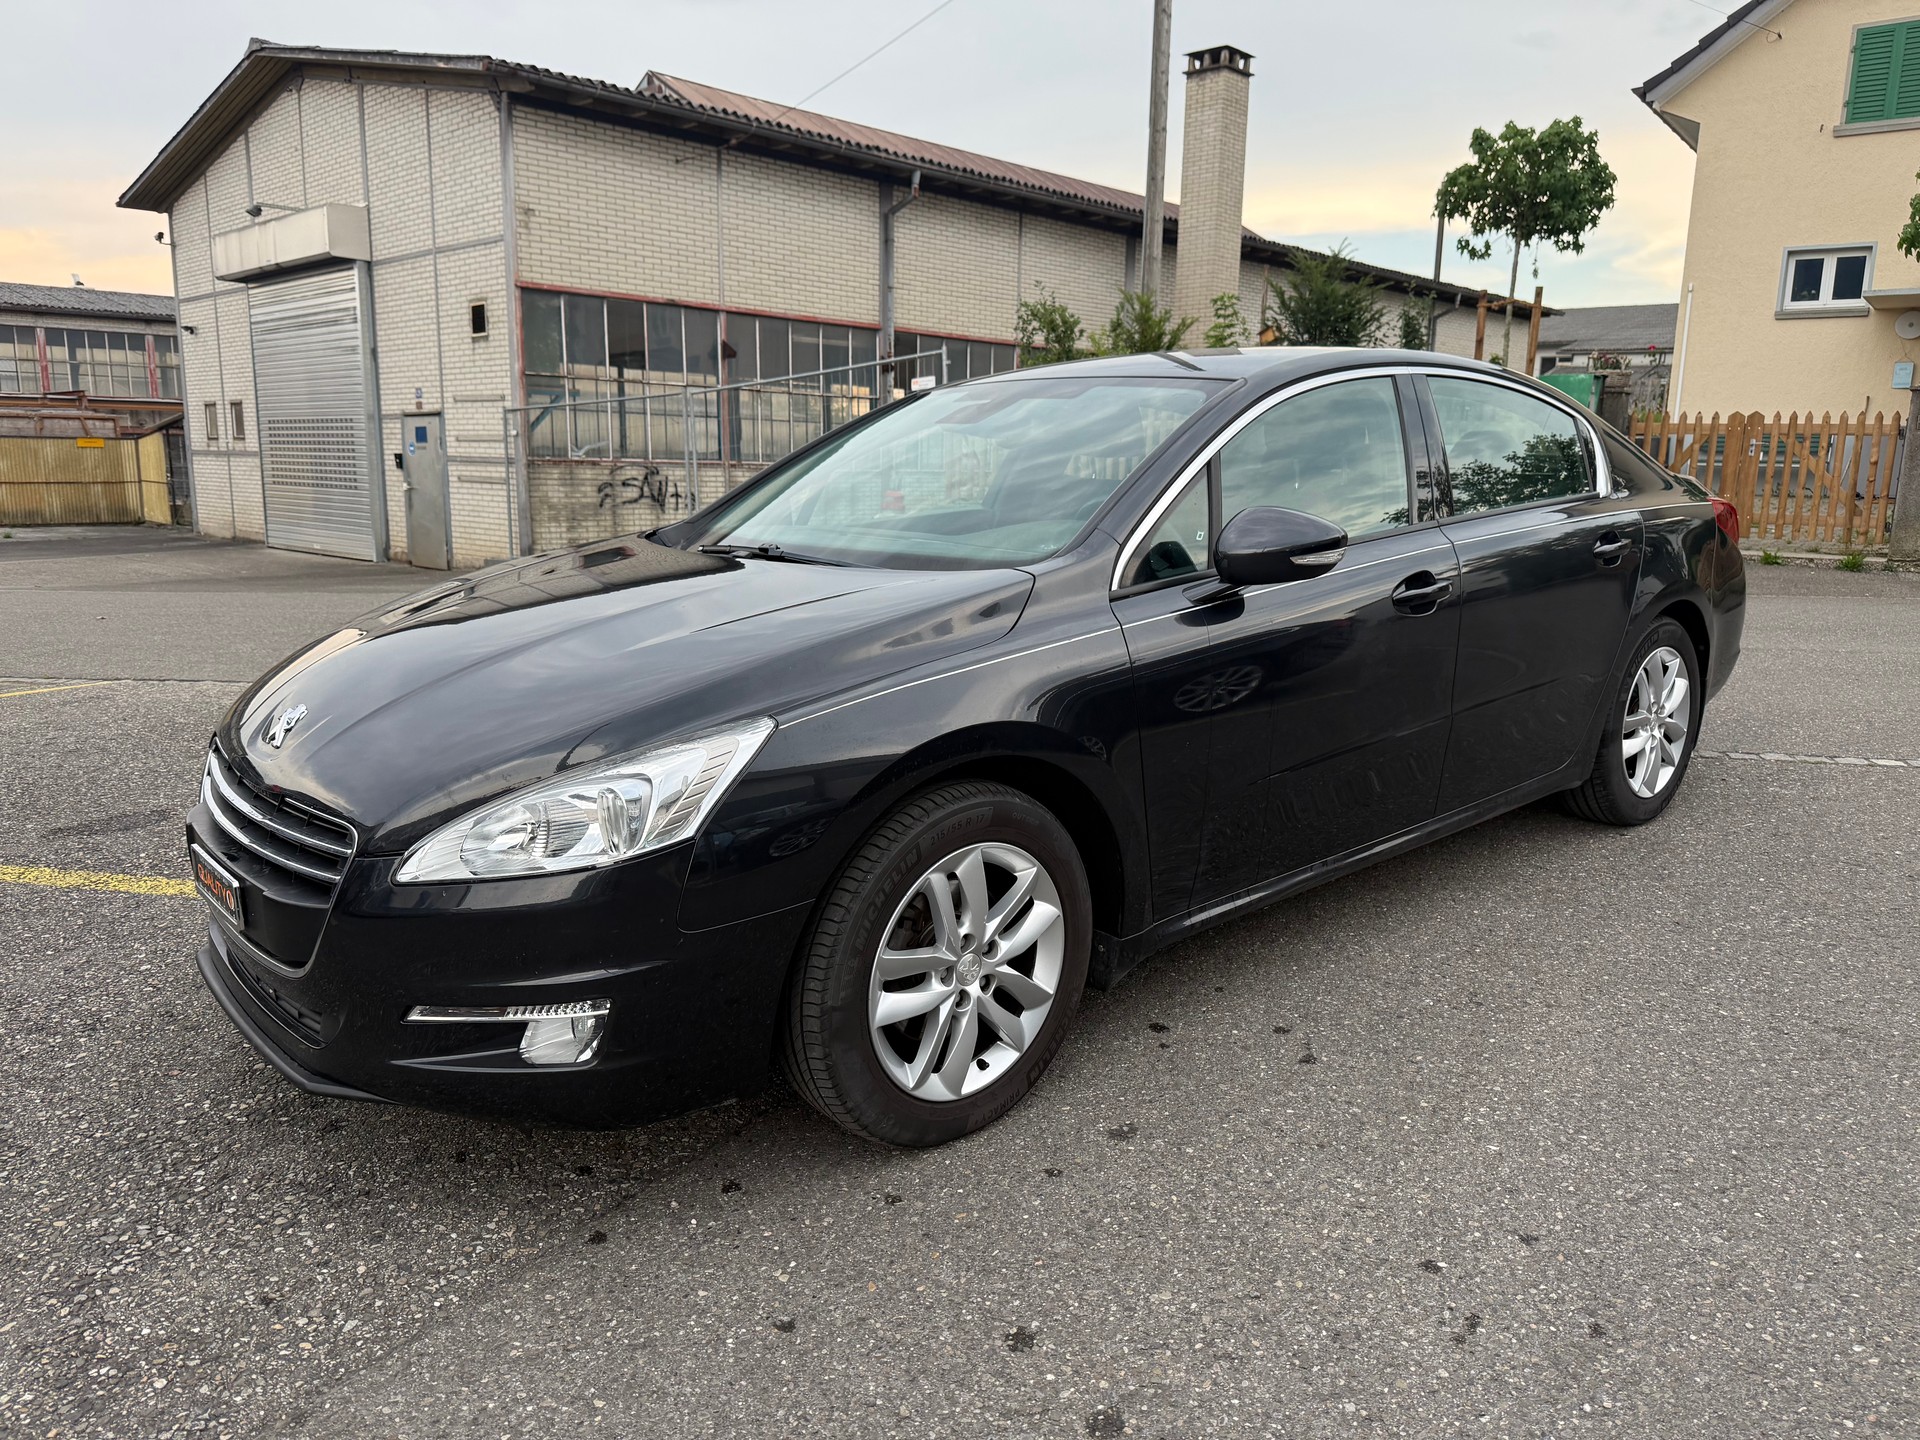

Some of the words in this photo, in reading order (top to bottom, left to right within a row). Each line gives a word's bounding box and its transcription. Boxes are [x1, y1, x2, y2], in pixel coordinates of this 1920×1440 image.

[931, 820, 963, 847] 215/55
[965, 816, 972, 828] R
[976, 813, 986, 825] 17
[855, 847, 919, 953] MICHELIN
[983, 1088, 1020, 1122] PRIMACY
